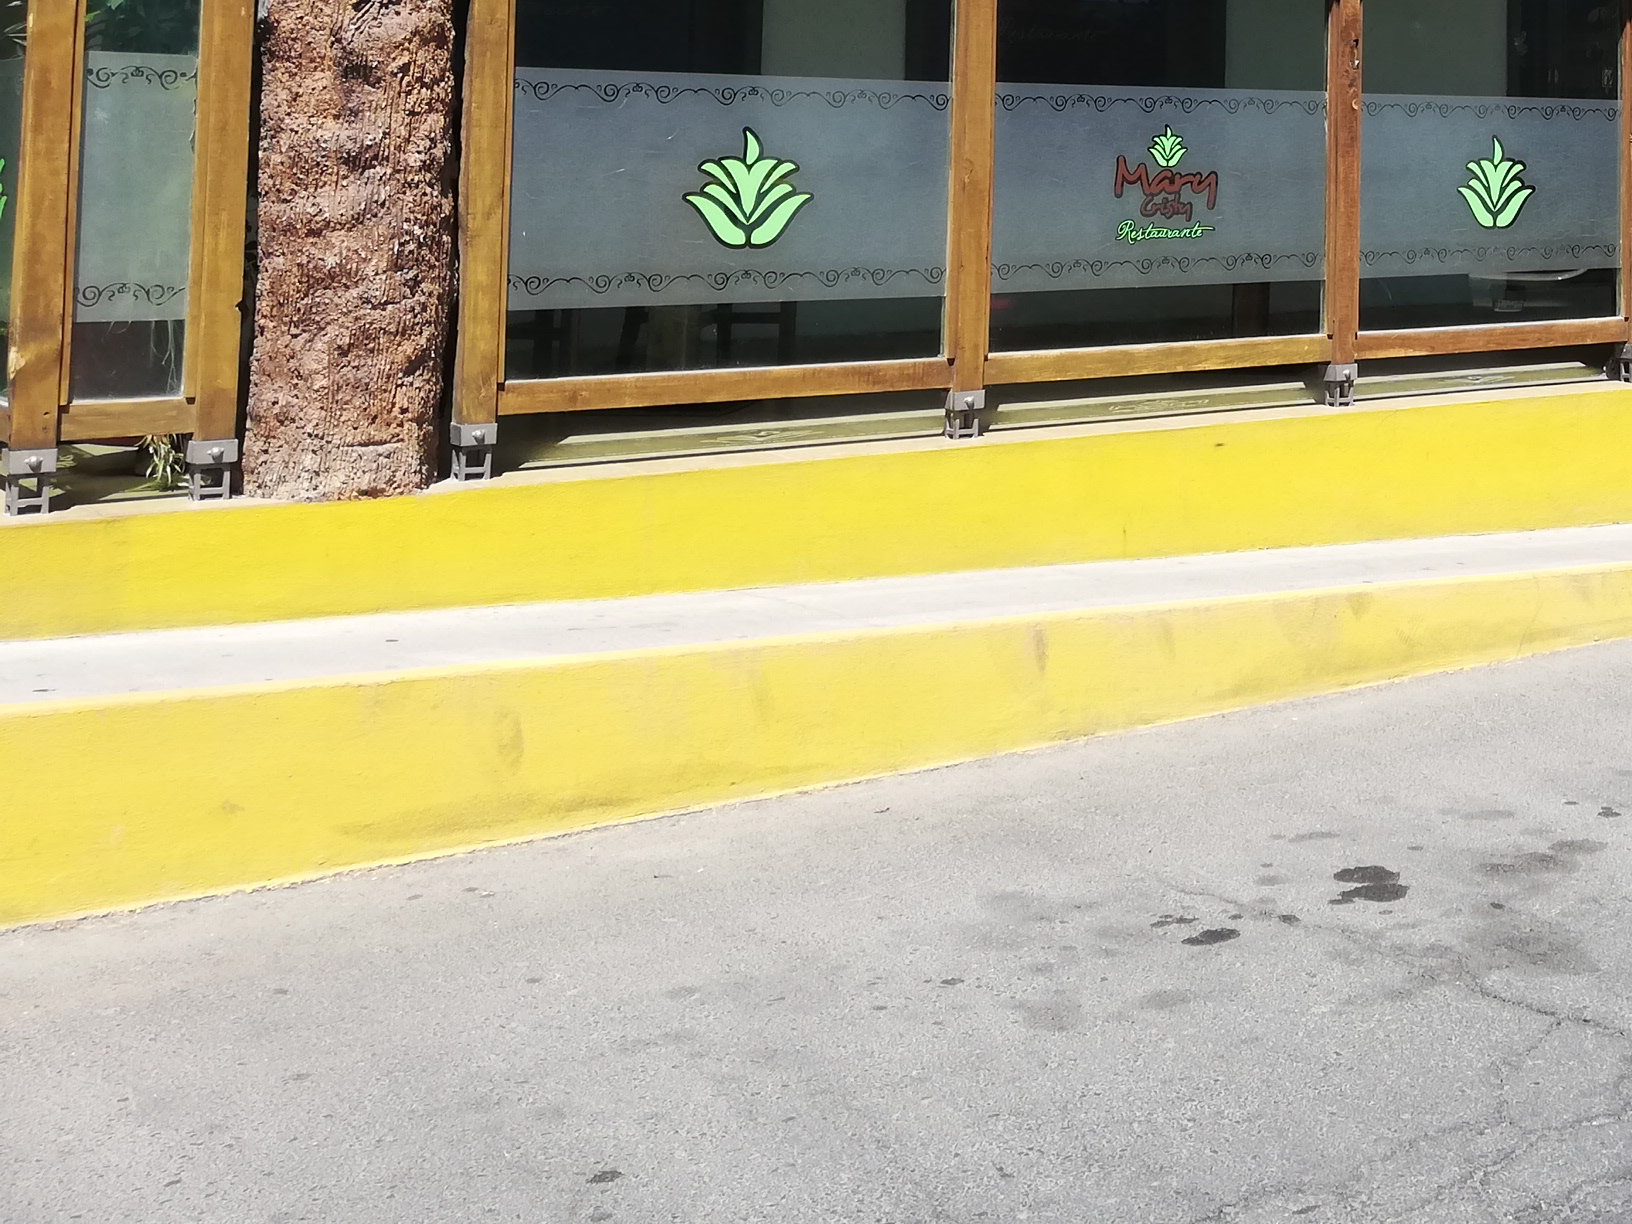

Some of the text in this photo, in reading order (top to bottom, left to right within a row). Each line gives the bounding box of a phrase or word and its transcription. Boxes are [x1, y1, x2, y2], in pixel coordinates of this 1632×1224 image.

[1114, 155, 1218, 210] Mary
[1140, 195, 1193, 222] Cristy
[1115, 219, 1216, 245] Restaurante
